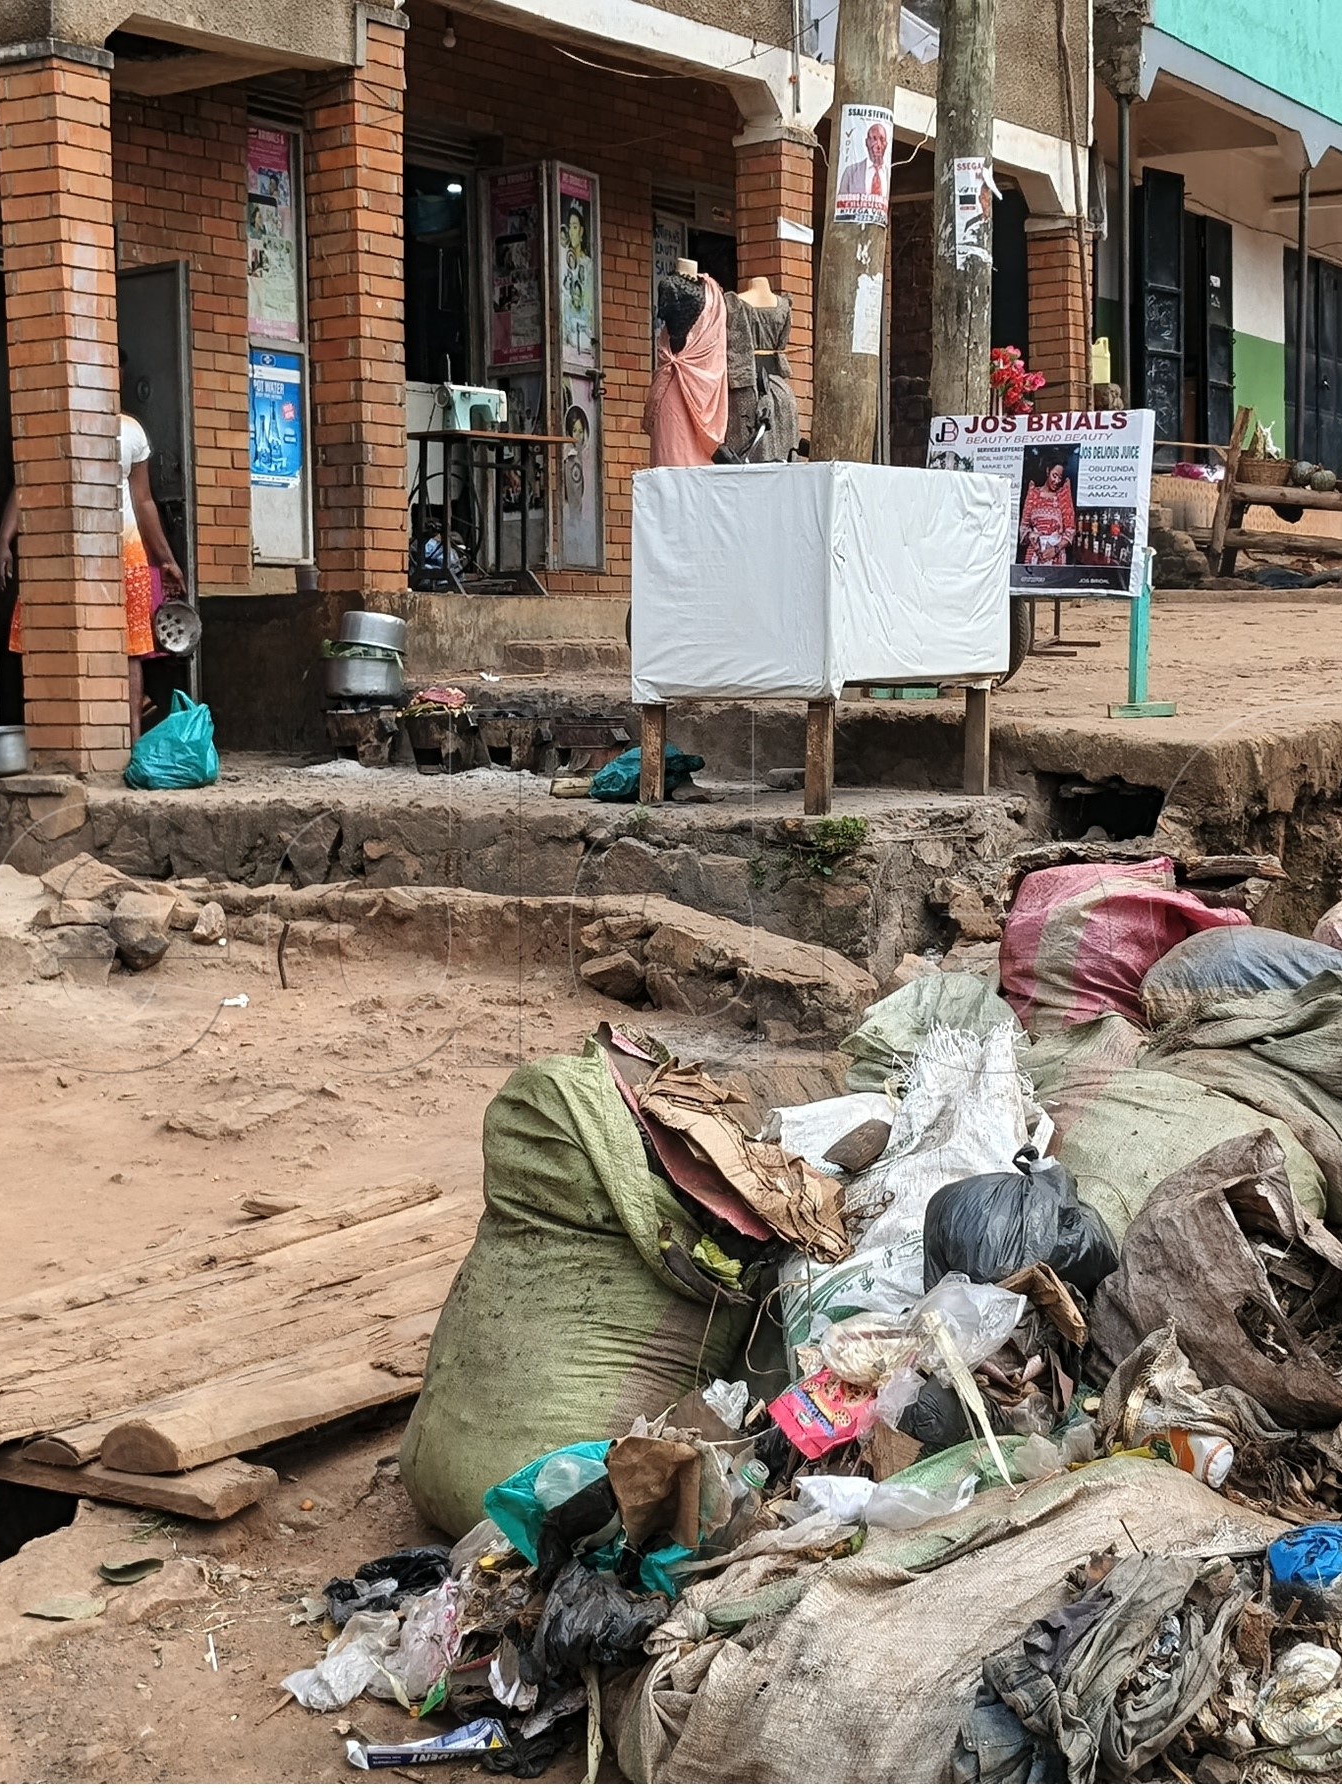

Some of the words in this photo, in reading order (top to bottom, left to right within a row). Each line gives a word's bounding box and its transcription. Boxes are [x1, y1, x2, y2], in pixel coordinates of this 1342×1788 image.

[965, 416, 1017, 434] JOS
[1027, 411, 1128, 432] BRIALS
[965, 435, 1012, 444] BEAUTY
[1014, 434, 1062, 443] BEYOND
[1064, 433, 1113, 442] BEAUTY
[1120, 446, 1140, 459] JUICE
